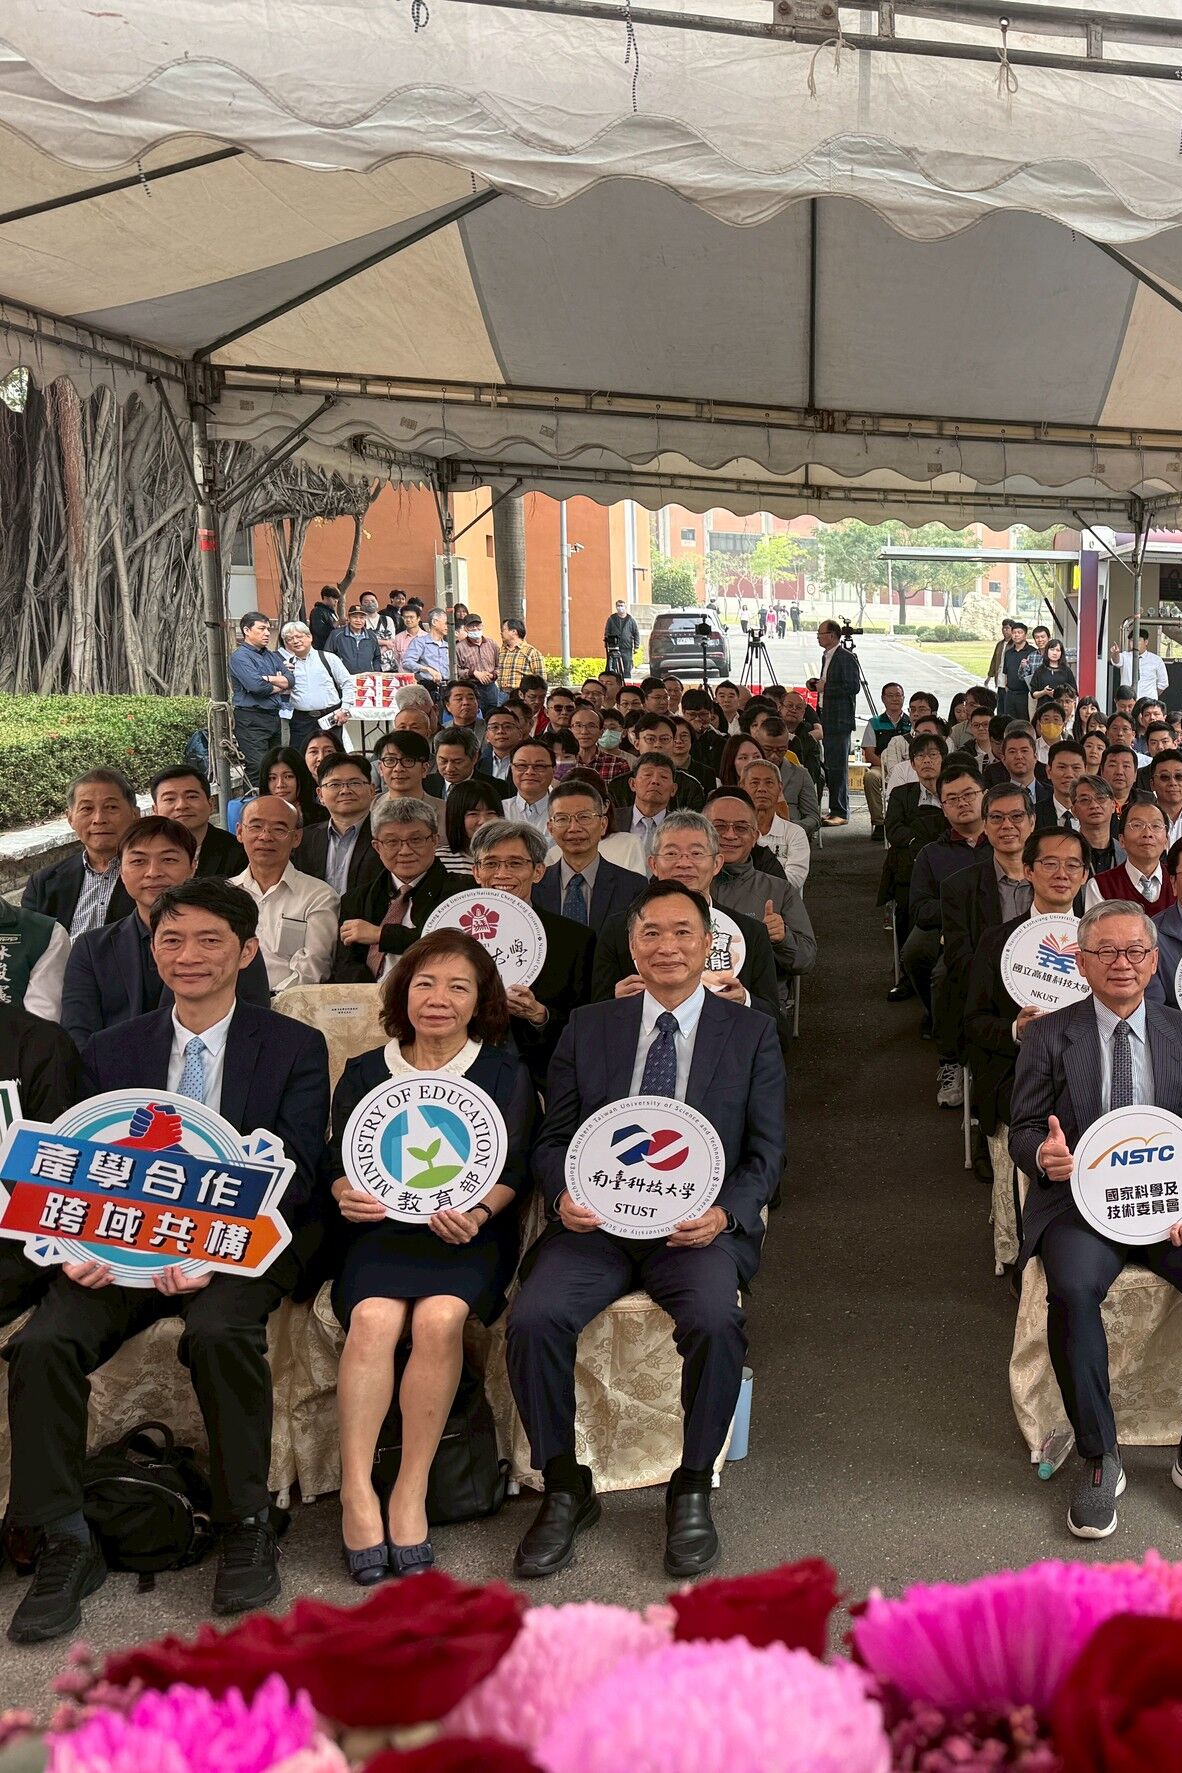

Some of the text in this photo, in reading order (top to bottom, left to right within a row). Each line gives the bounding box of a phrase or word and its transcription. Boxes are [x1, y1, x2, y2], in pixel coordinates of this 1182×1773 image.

[1013, 962, 1090, 993] 國立高雄科技大學
[1030, 989, 1059, 1003] NKUST
[357, 1085, 492, 1198] MINISTRY OF EDUCATION
[573, 1123, 594, 1153] Southern
[593, 1107, 618, 1123] Taiwan
[620, 1100, 661, 1110] University
[675, 1105, 700, 1124] Science
[700, 1124, 711, 1135] and
[709, 1136, 721, 1174] Technology
[1110, 1145, 1175, 1167] NSTC
[30, 1140, 244, 1208] 產學合作
[588, 1169, 696, 1200] 南臺科技大學
[397, 1170, 483, 1213] 教育部
[1104, 1181, 1179, 1203] 國家科學及
[614, 1202, 658, 1218] STUST
[1106, 1198, 1180, 1220] 技術委員會
[38, 1192, 251, 1262] 跨域共構
